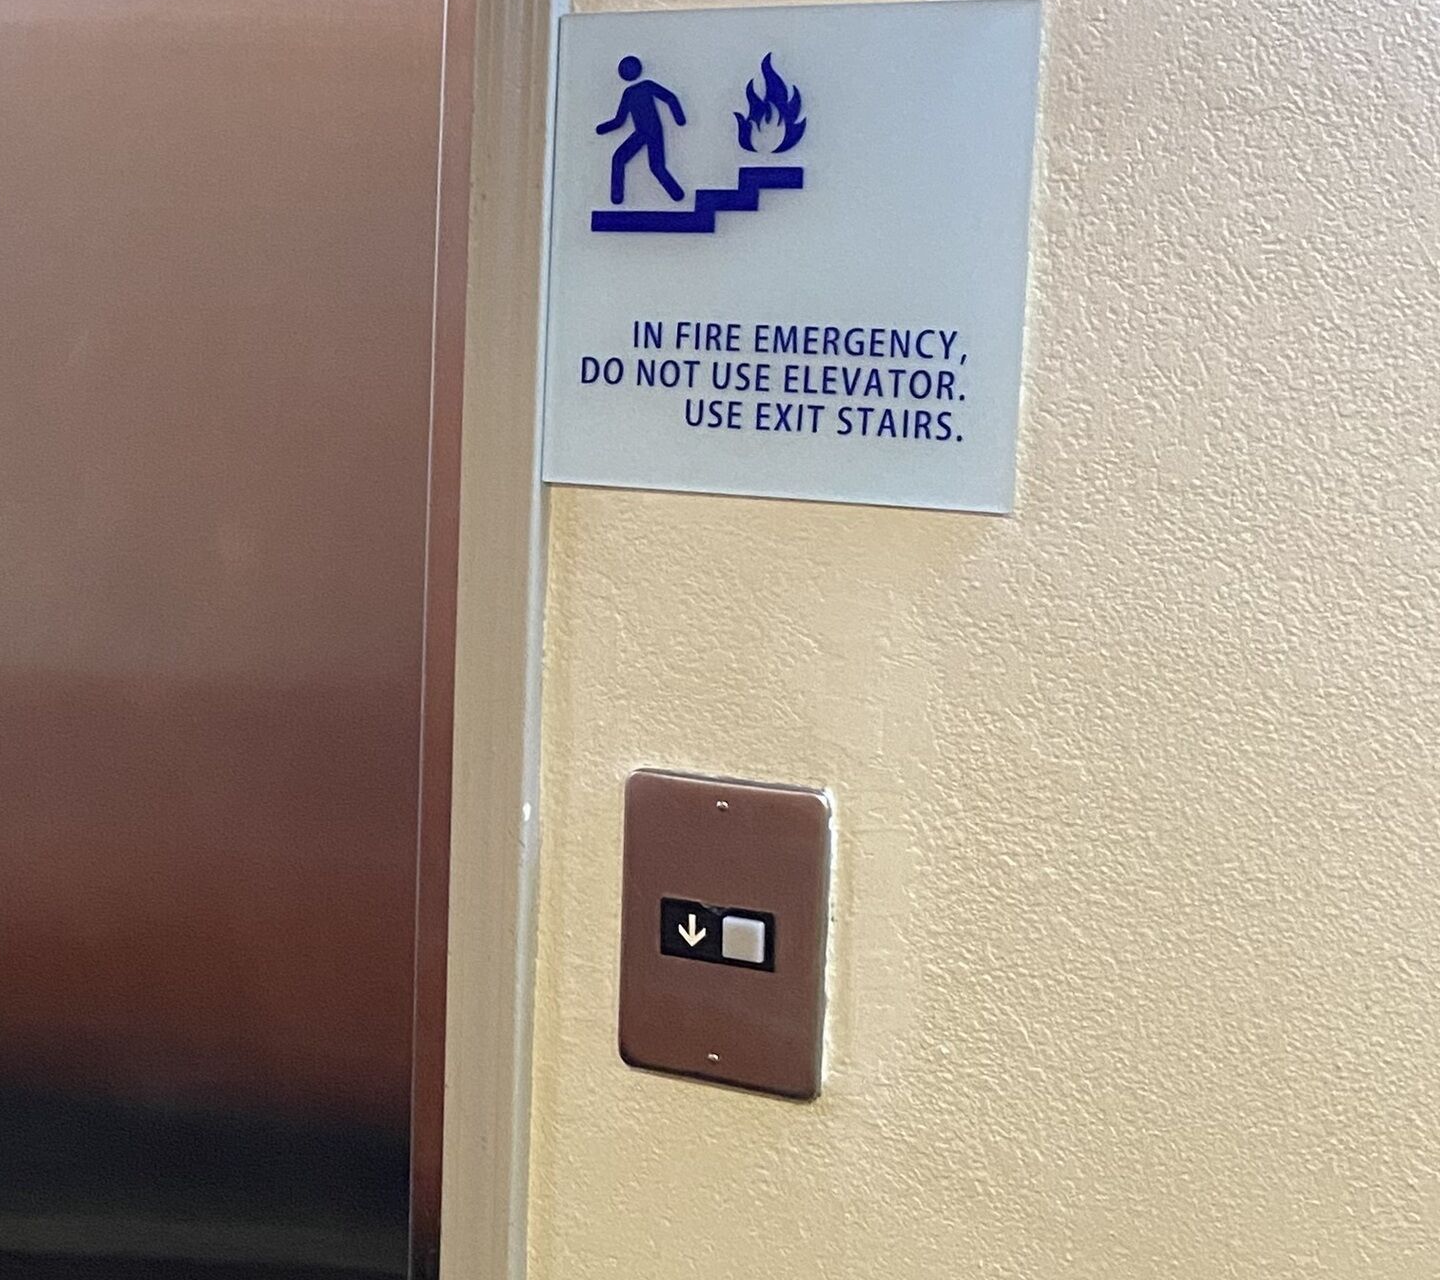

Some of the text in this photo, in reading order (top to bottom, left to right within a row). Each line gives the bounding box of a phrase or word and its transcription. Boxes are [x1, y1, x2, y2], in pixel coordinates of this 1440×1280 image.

[633, 320, 967, 366] IN FIRE EMERGENCY,
[580, 356, 966, 402] DO NOT USE ELEVATOR.
[685, 398, 963, 443] USE EXIT STAIRS.
